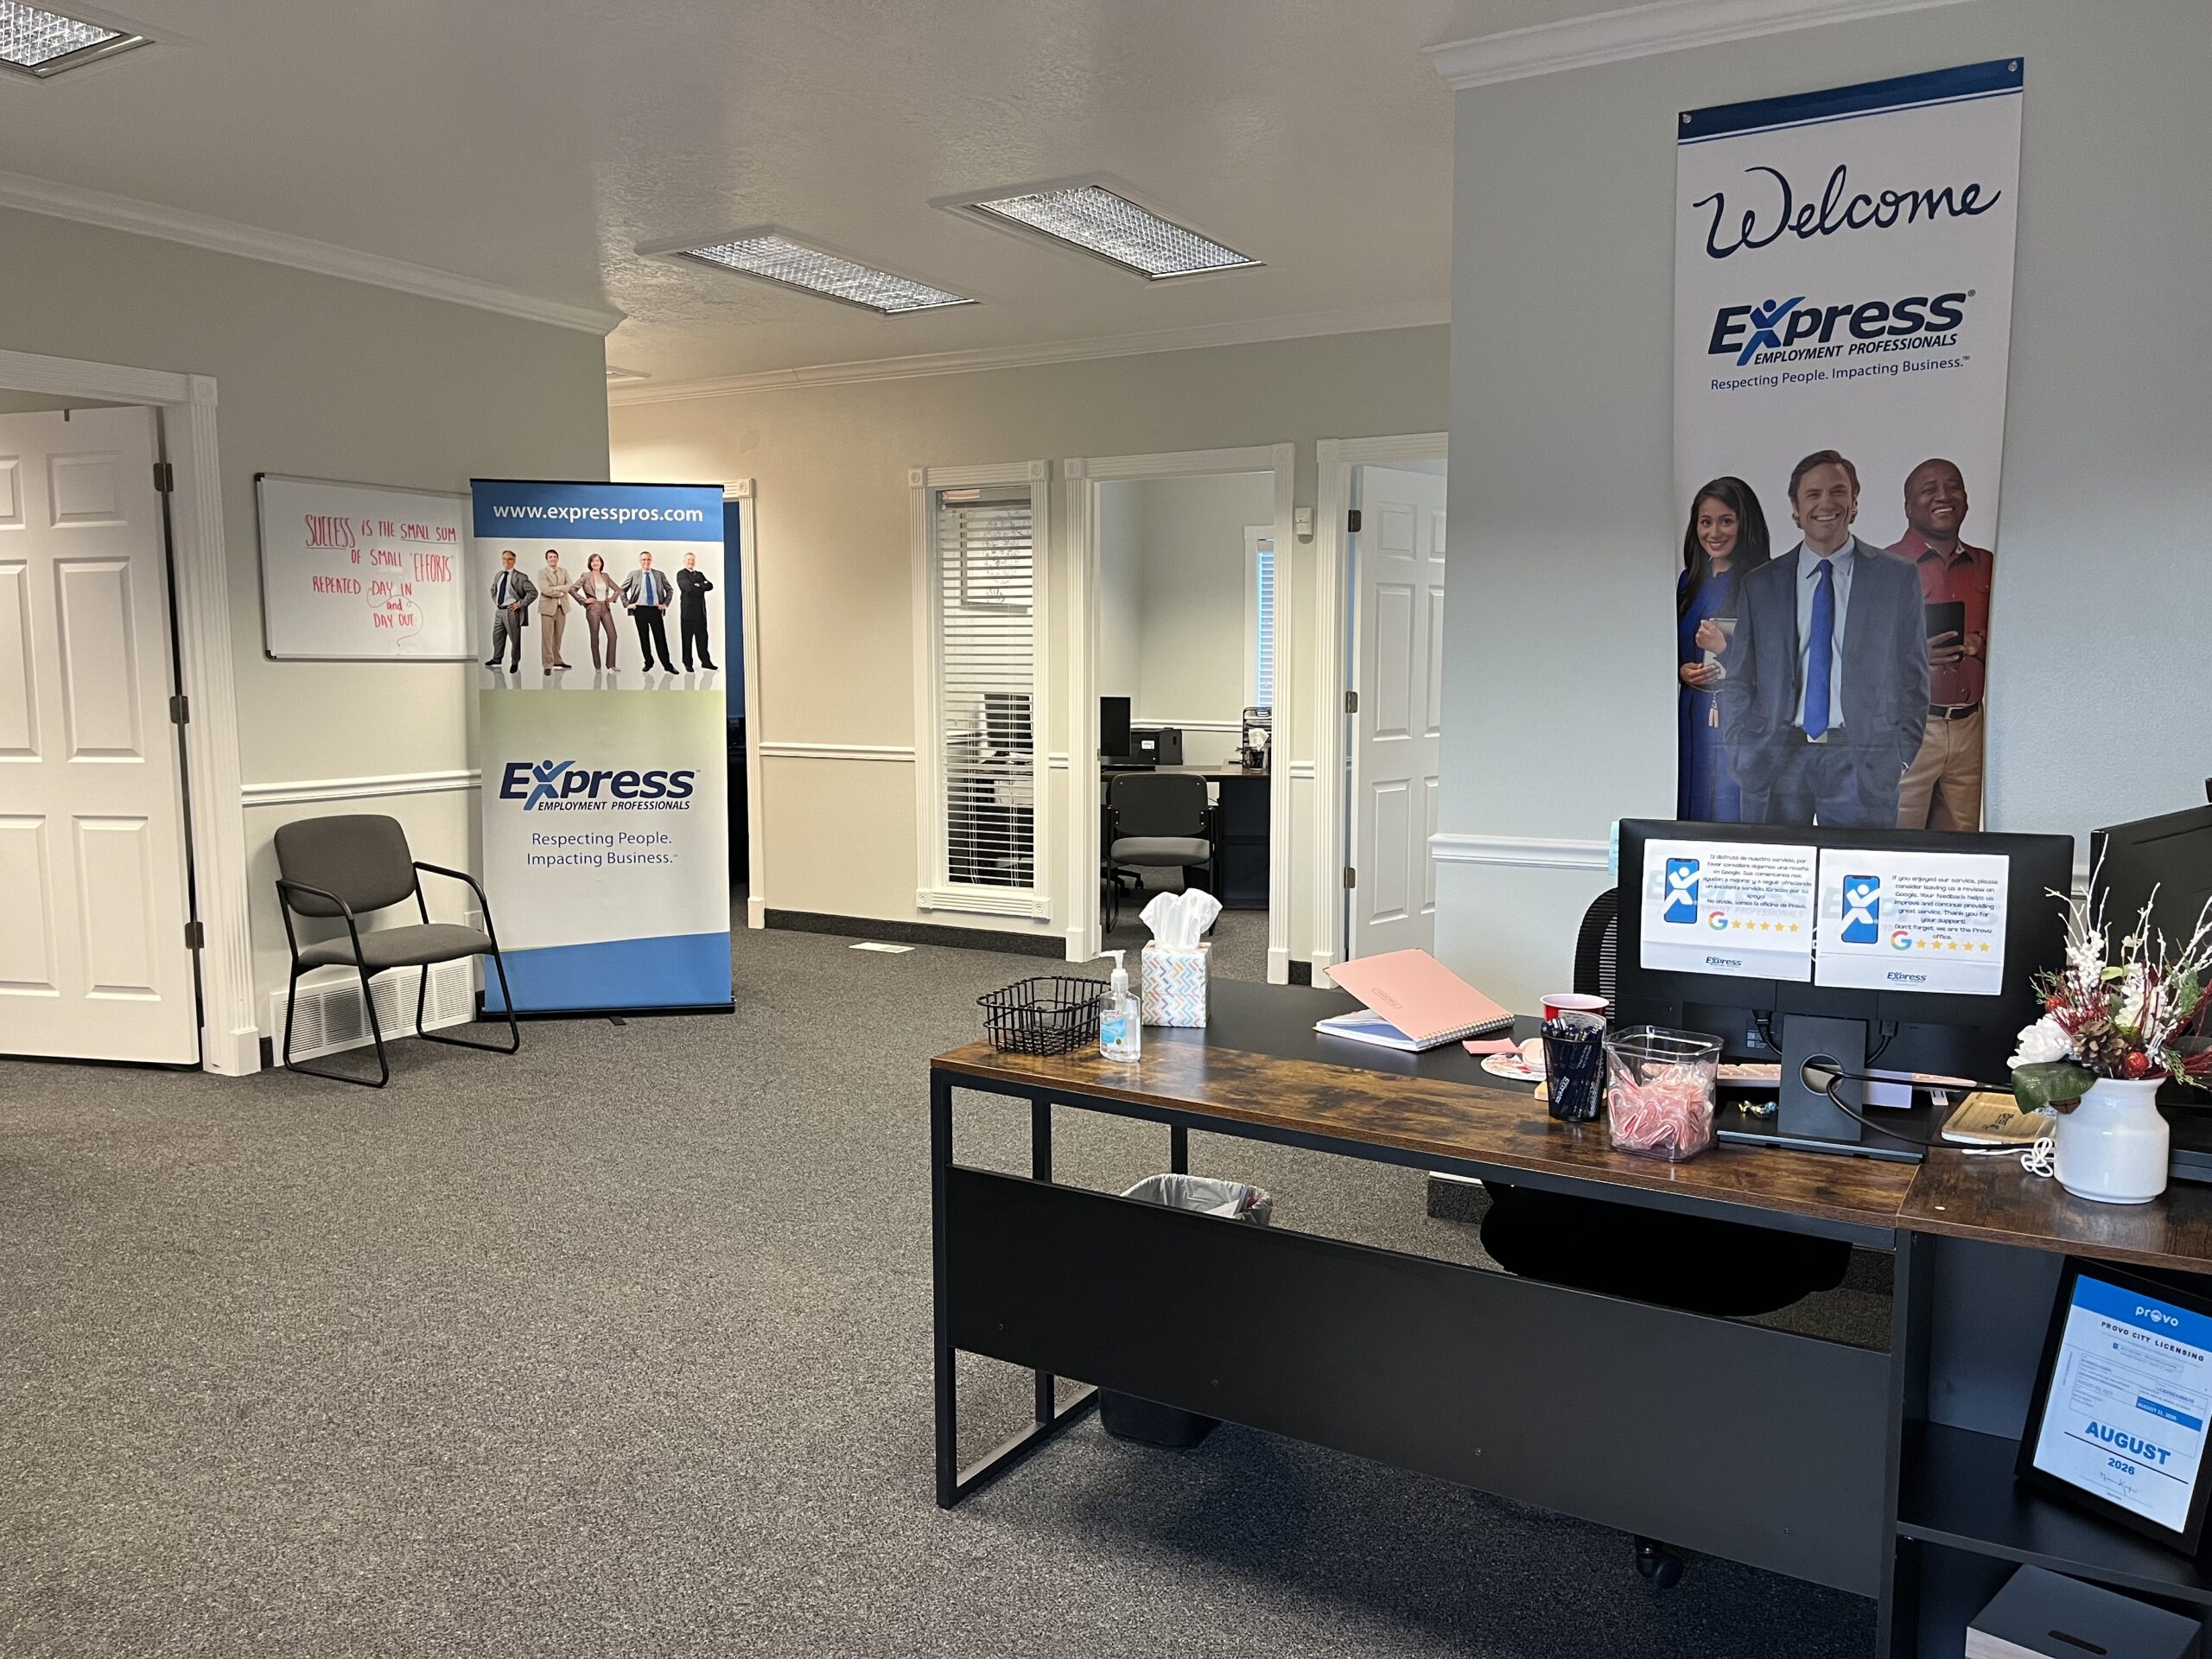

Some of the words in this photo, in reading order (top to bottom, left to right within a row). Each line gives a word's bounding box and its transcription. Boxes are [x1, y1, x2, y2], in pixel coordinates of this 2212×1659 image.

[1693, 164, 2001, 258] Welcome
[1754, 345, 1844, 365] EMPLOYMENT
[1847, 333, 1958, 356] PROFESSIONALS
[1711, 374, 1778, 391] Respecting
[1782, 369, 1829, 385] People.
[1832, 363, 1898, 379] Impacting
[493, 505, 703, 524] www.expresspros.com
[305, 514, 355, 548] SUCCESS
[361, 519, 372, 537] IS
[378, 521, 395, 537] THE
[400, 524, 429, 540] SMALL
[435, 527, 456, 542] SUM
[351, 550, 361, 564] OF
[370, 550, 403, 567] SMALL
[312, 575, 361, 594] REPEATED
[372, 581, 393, 597] DAY
[400, 582, 412, 596] IN
[386, 599, 403, 611] and
[373, 613, 393, 628] DAY
[398, 613, 414, 626] OUT
[537, 801, 607, 811] EMPLOYMENT
[611, 800, 690, 810] PROFESSIONALS
[532, 832, 613, 848] Respecting
[619, 831, 672, 847] People.
[527, 852, 602, 868] Impacting
[1923, 884, 1947, 893] leaving
[1894, 899, 1920, 908] improve
[2135, 1306, 2179, 1327] provo
[2101, 1321, 2129, 1336] PROVO
[2133, 1332, 2151, 1343] CITY
[2155, 1340, 2205, 1362] LICENSING
[2085, 1421, 2171, 1465] AUGUST
[2107, 1458, 2136, 1475] 2026
